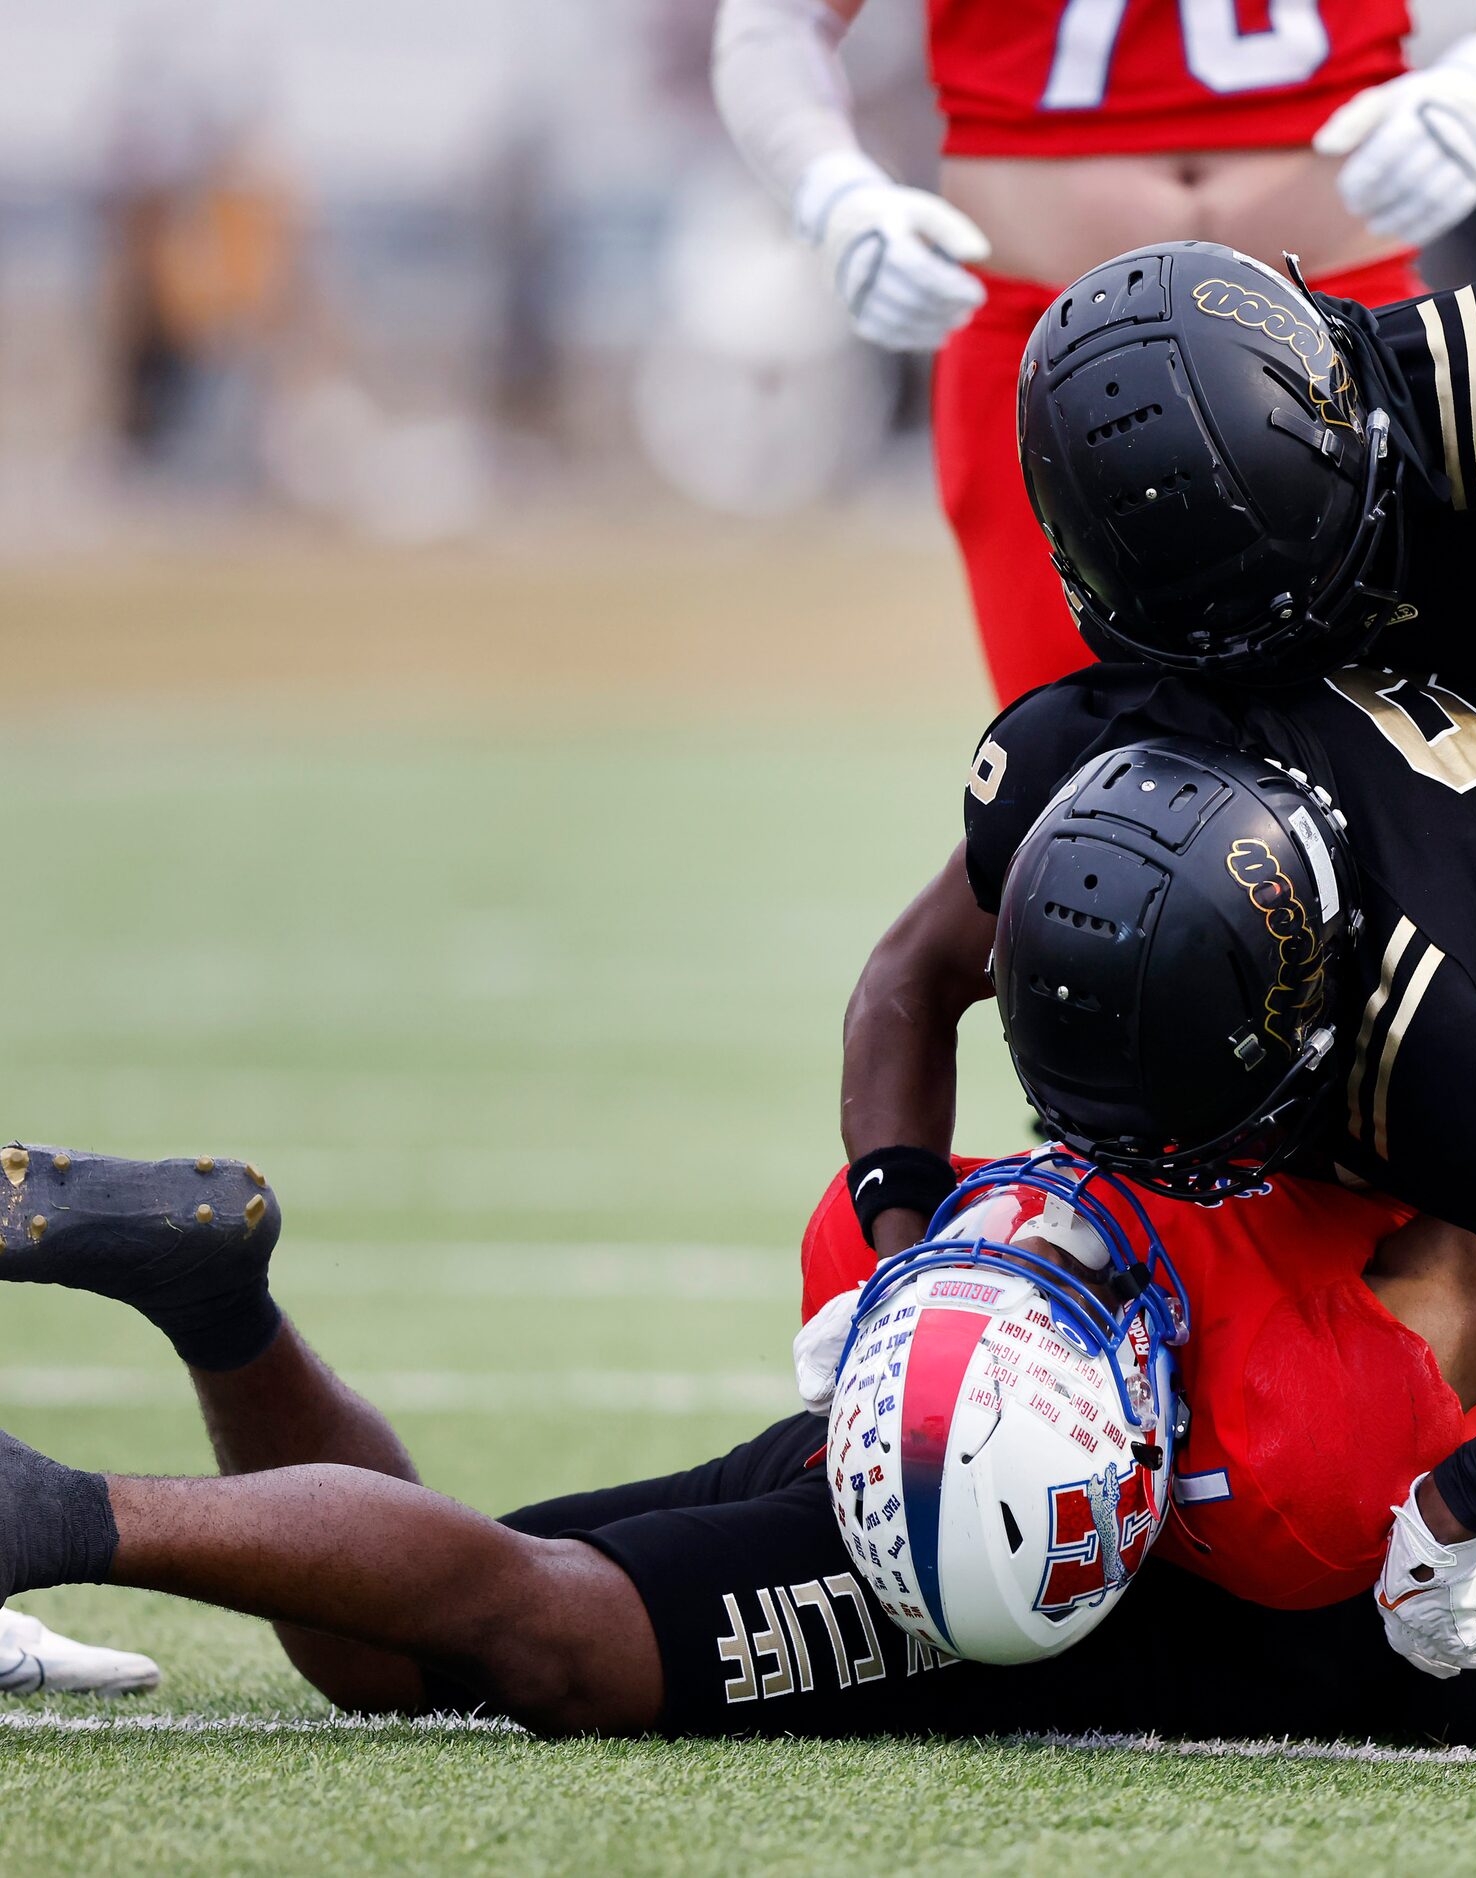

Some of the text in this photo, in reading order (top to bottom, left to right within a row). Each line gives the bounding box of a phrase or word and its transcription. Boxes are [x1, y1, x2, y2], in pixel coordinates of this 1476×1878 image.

[930, 1281, 1004, 1304] JAGUARS
[998, 1320, 1104, 1389] FIGHT FIGHT FIGHT
[878, 1395, 896, 1416] 22
[968, 1387, 1004, 1411] FIGHT
[987, 1340, 1127, 1449] FIGHT FIGHT FIGHT FIGHT
[984, 1363, 1099, 1453] FIGHT FIGHT FIGHT
[862, 1427, 878, 1449] 22
[850, 1472, 866, 1491] 22
[868, 1465, 885, 1485] 22
[882, 1494, 901, 1521] FEAST
[717, 1572, 886, 1704] CLIFF
